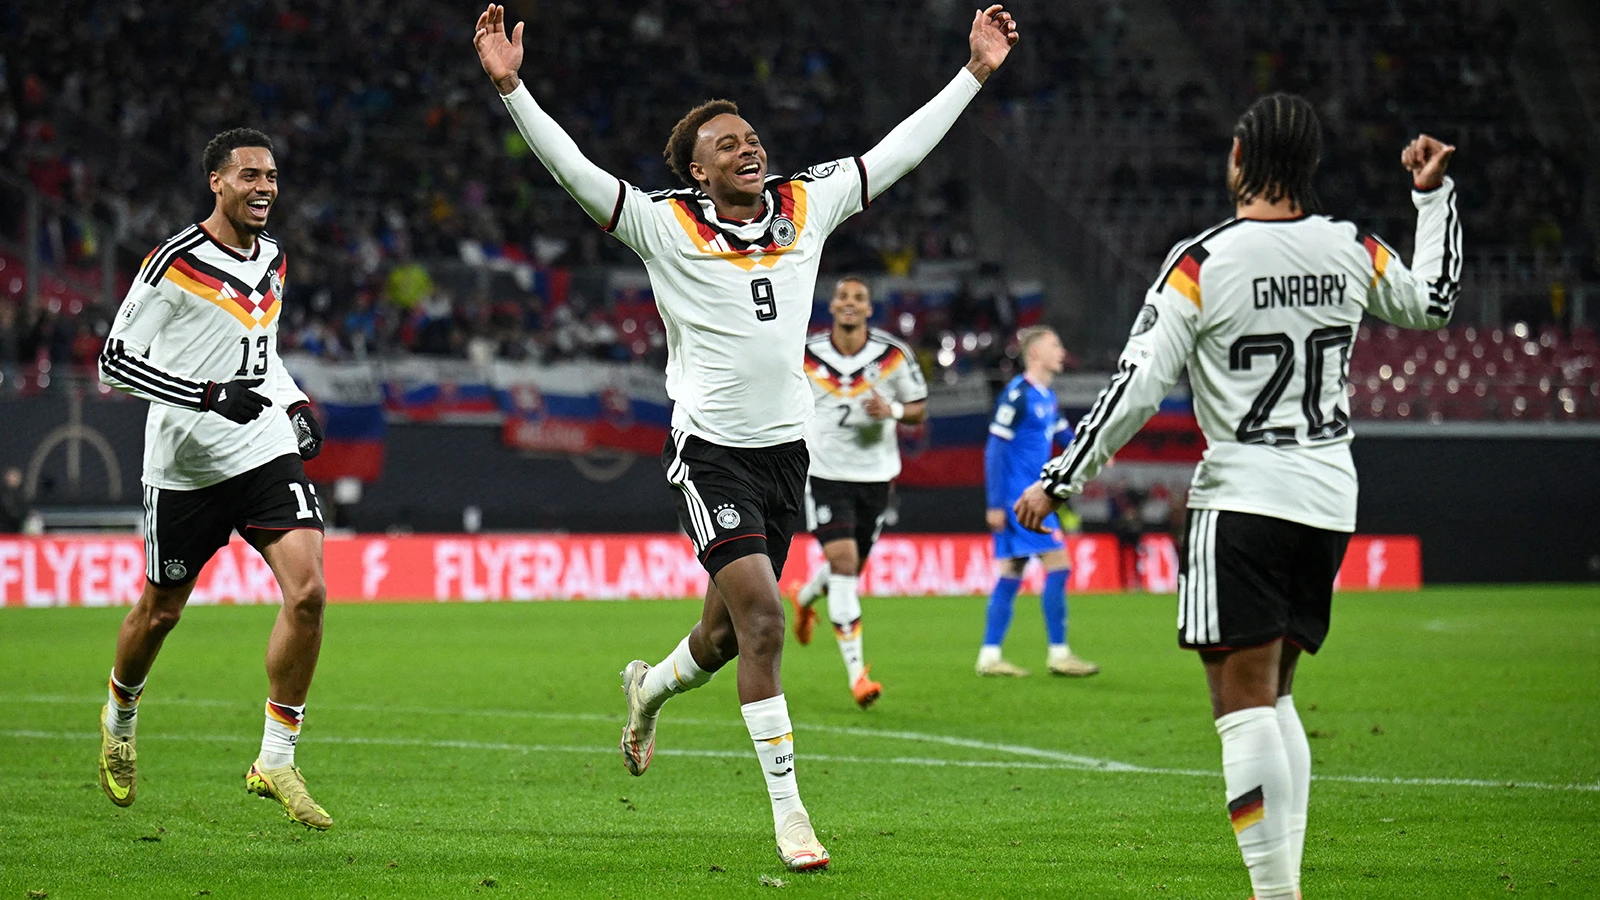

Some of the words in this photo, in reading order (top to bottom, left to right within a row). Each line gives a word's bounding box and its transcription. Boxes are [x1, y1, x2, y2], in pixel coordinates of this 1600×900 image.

[750, 277, 777, 322] 9
[1253, 274, 1347, 310] GNABRY
[236, 335, 269, 377] 13
[1229, 325, 1355, 446] 20
[837, 404, 853, 428] 2
[775, 753, 794, 765] DFB
